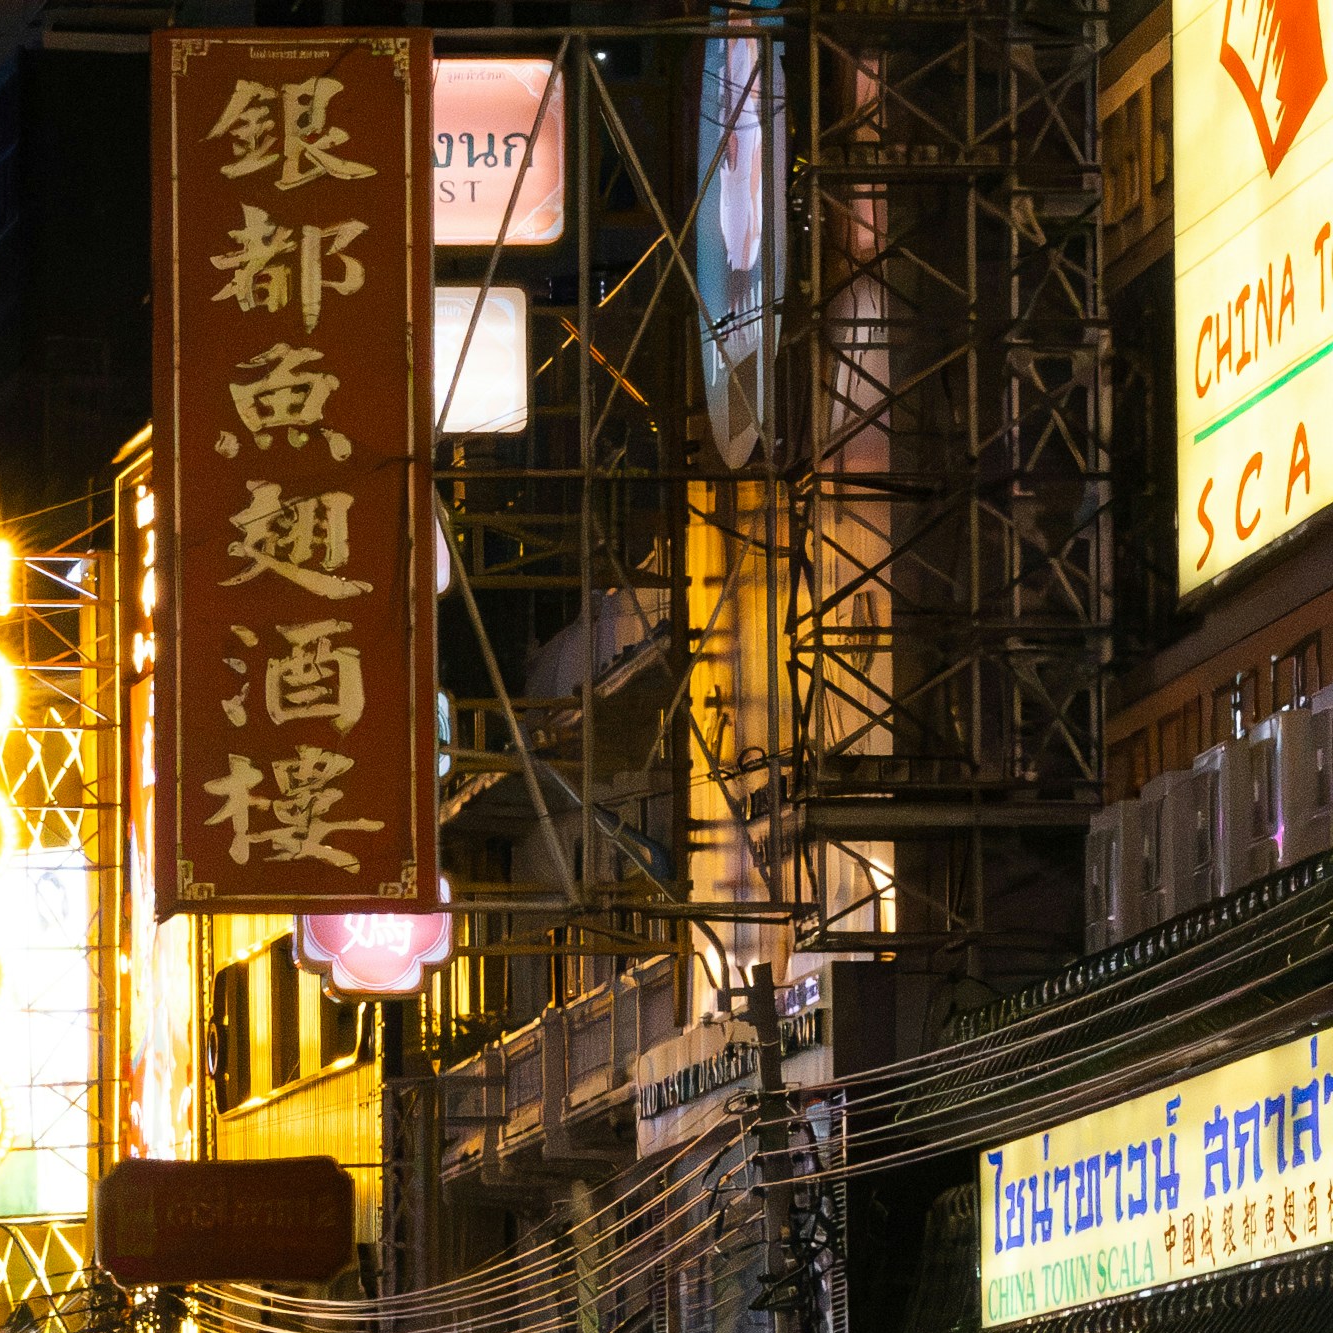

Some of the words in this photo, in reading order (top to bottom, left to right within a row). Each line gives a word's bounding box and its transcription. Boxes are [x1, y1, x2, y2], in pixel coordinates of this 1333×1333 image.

[1194, 253, 1295, 398] CHINA
[199, 76, 384, 874] 銀都魚翅酒樓
[987, 1093, 1182, 1256] ไชน่าทาวน์
[1163, 1178, 1333, 1276] 中國城銀都魚翅酒
[987, 1276, 1038, 1322] CHINA
[1041, 1254, 1092, 1308] TOWN
[1096, 1239, 1155, 1297] SCALA
